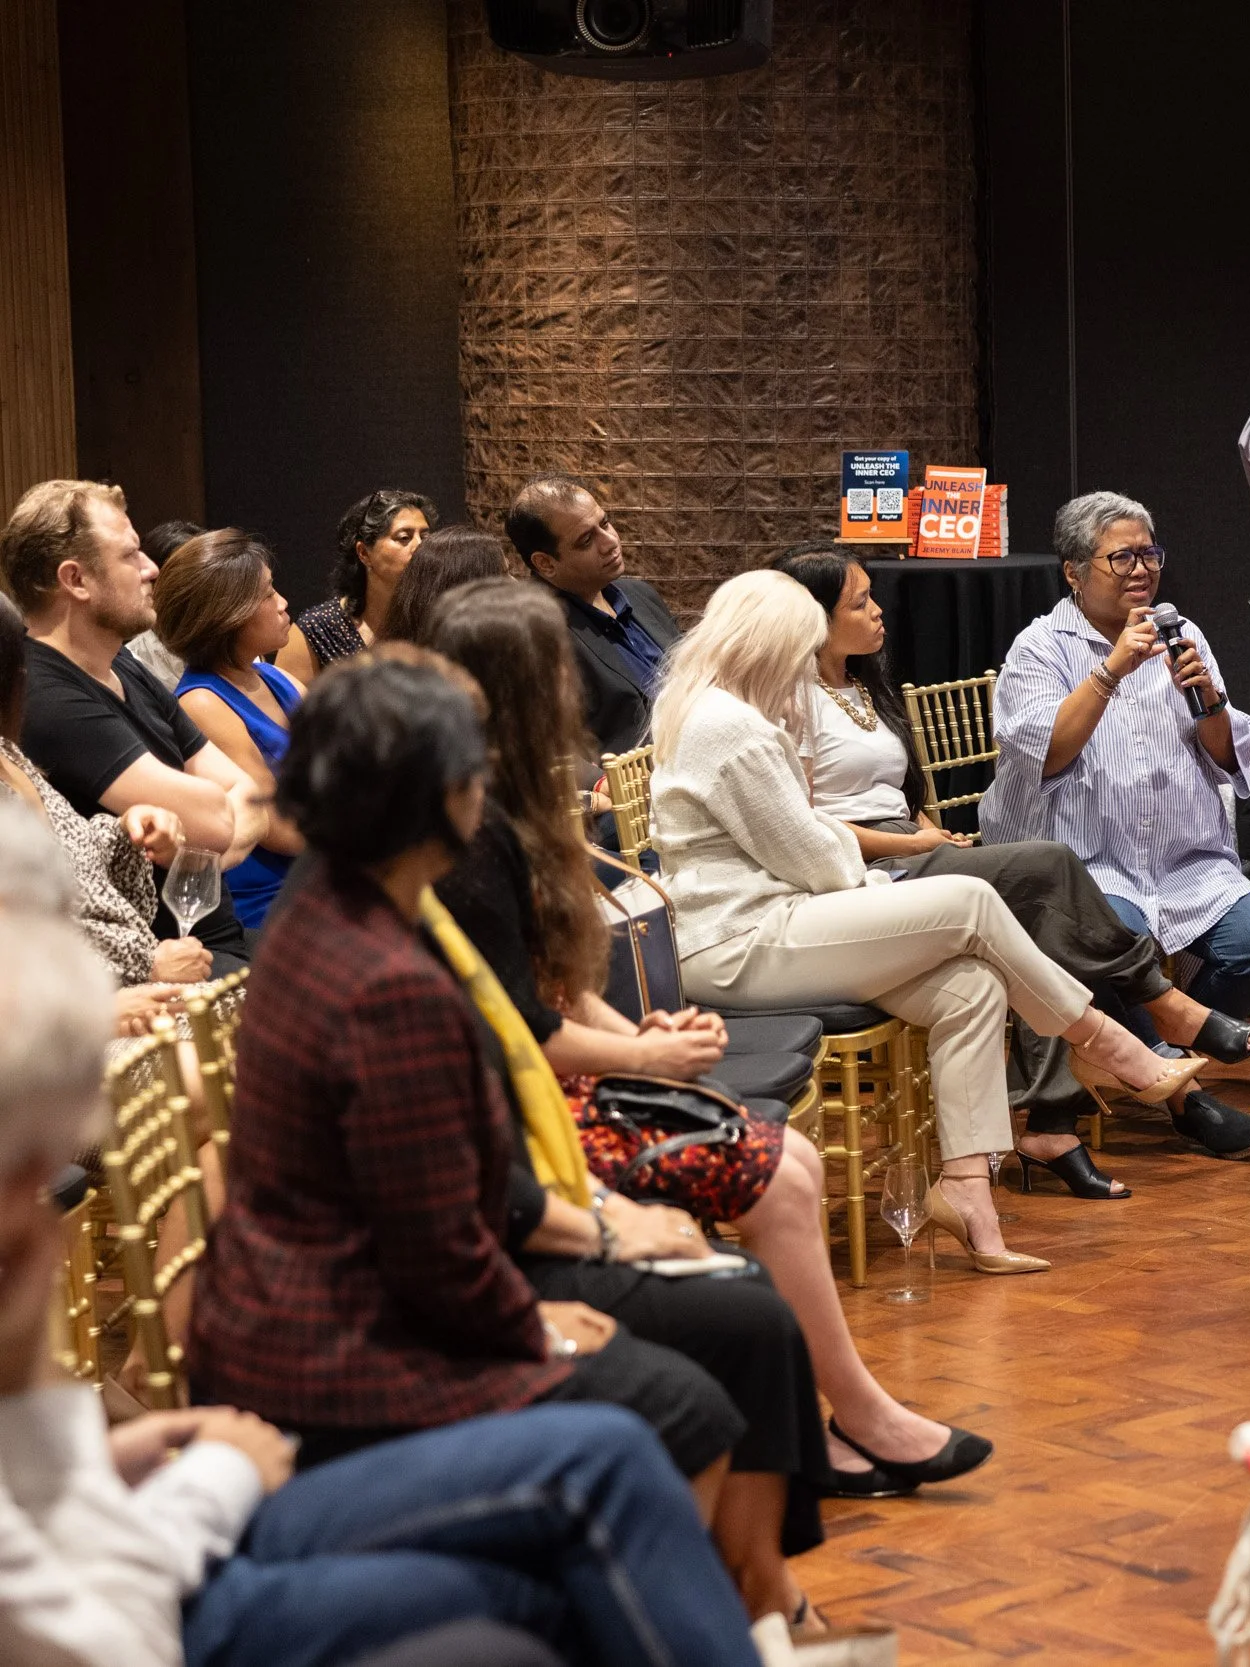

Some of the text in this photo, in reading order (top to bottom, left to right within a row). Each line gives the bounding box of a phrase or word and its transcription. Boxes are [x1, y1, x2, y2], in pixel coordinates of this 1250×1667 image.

[925, 480, 983, 492] UNLEASH
[922, 498, 980, 514] INNER
[920, 514, 979, 539] CEO
